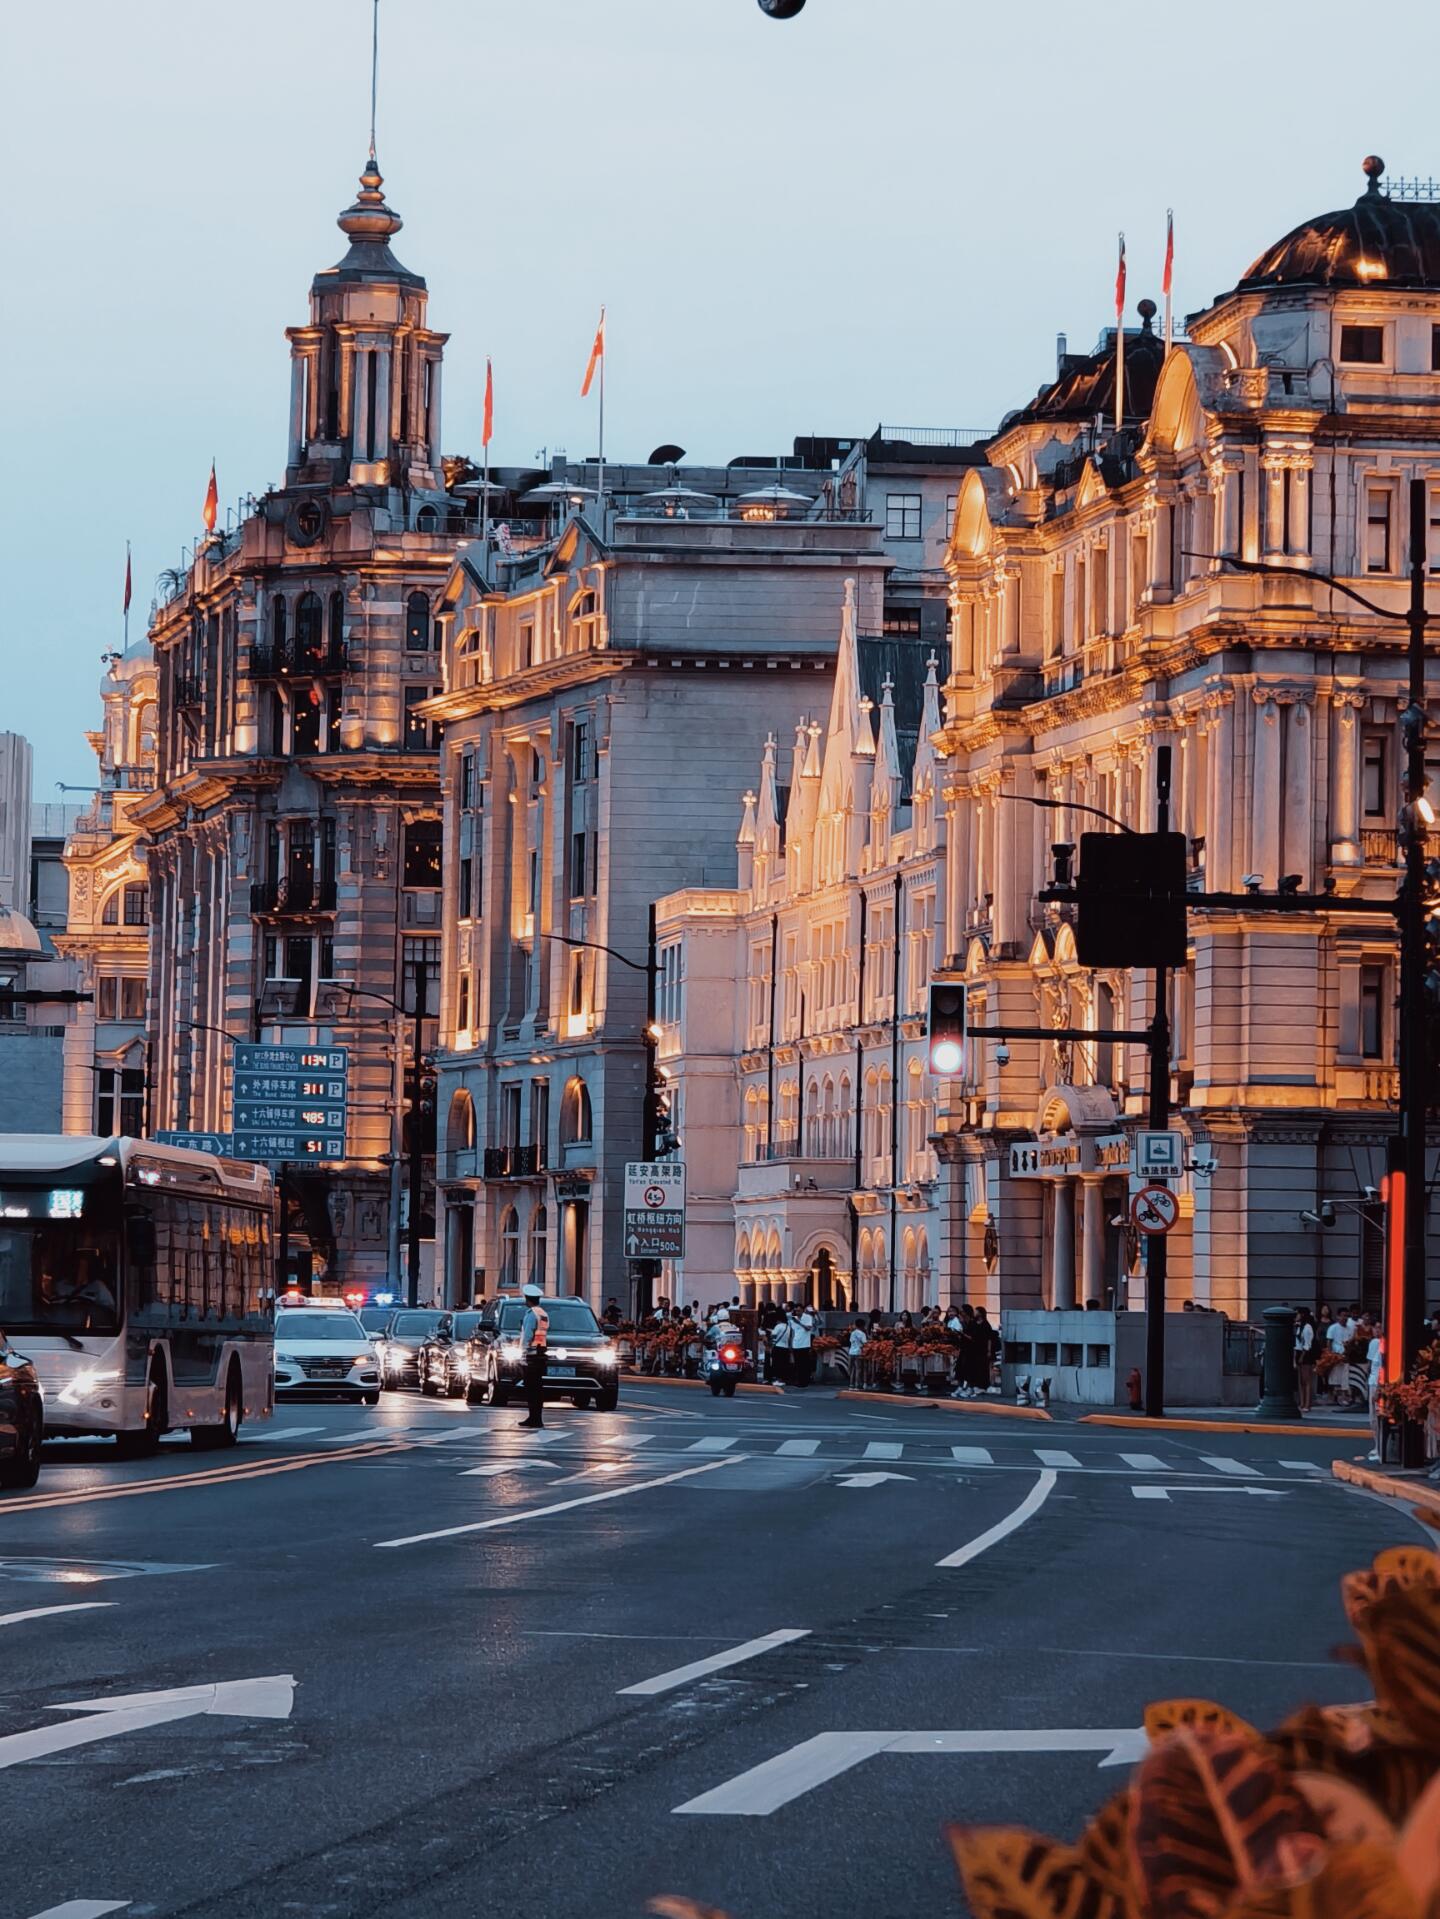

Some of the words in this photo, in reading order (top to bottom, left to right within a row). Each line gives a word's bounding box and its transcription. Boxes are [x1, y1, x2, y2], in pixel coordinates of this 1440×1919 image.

[301, 1054, 327, 1066] 1134
[252, 1080, 296, 1091] 外滩停车库
[303, 1083, 324, 1095] 311
[628, 1164, 682, 1177] 延安高架路
[1141, 1166, 1179, 1175] 违法抓拍
[627, 1212, 682, 1225] 虹桥枢纽方向
[641, 1237, 660, 1247] 入口
